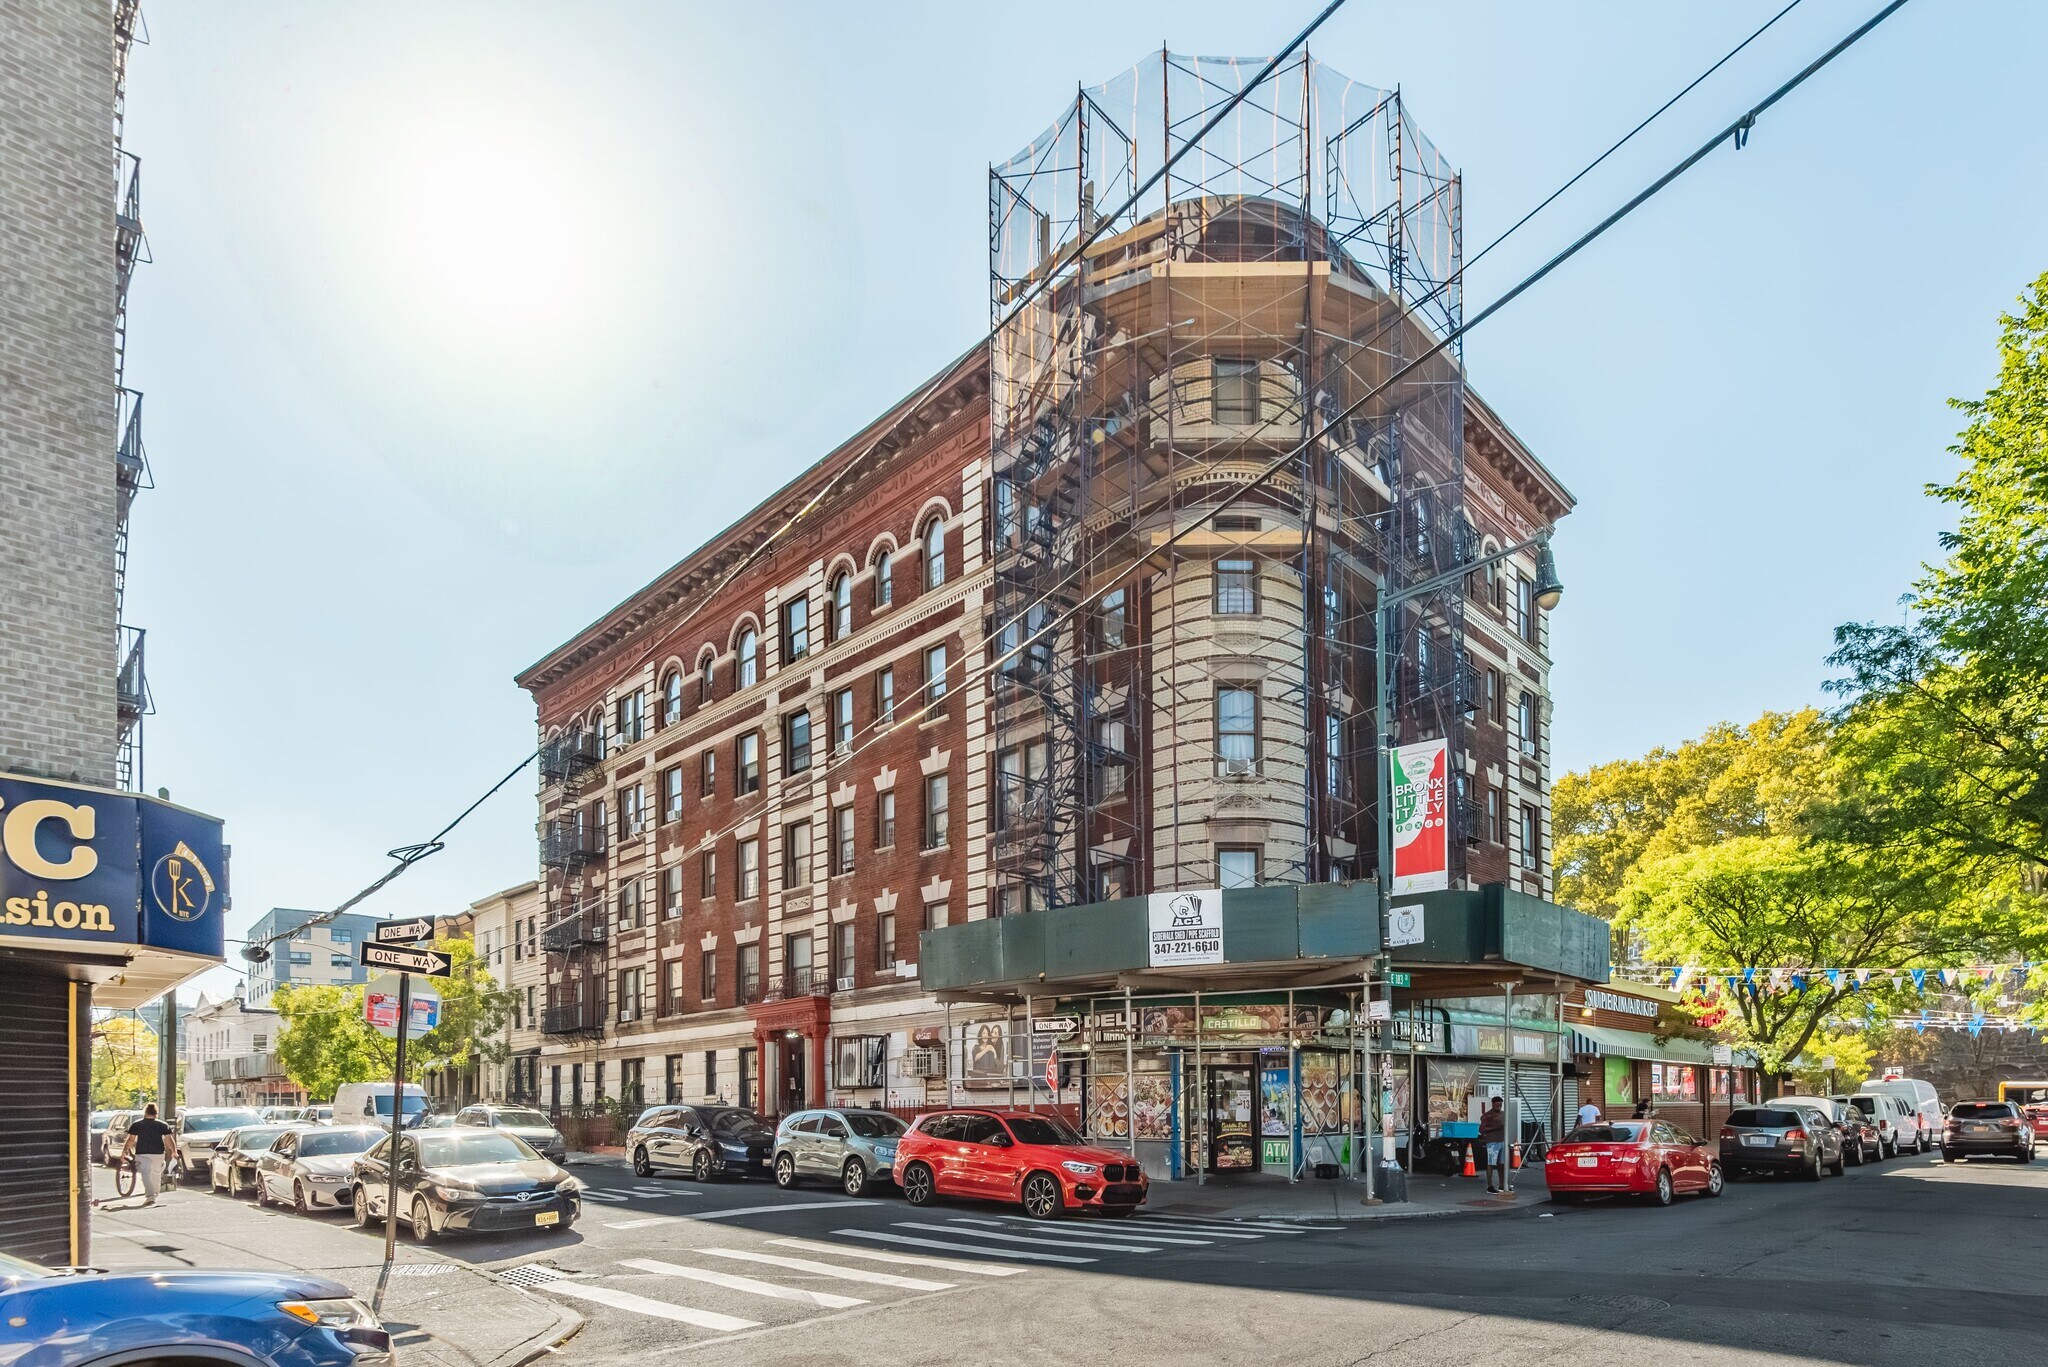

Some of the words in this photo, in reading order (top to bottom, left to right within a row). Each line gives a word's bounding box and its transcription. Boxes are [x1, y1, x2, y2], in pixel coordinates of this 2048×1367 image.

[1395, 777, 1444, 797] BRONX
[1395, 789, 1444, 808] LITTLE
[1396, 802, 1444, 820] ITALY
[1173, 917, 1202, 926] ACE
[384, 927, 402, 938] ONE
[408, 923, 427, 935] WAY
[1153, 931, 1174, 941] SIDEWALK
[1174, 930, 1186, 940] SHED
[1188, 928, 1198, 938] PIPE
[1198, 928, 1219, 938] SCAFFOLD
[1154, 940, 1219, 955] 347-221-6610
[374, 951, 401, 964] ONE
[413, 956, 439, 969] WAY
[1584, 990, 1659, 1018] SUPERMARKET
[1039, 1021, 1053, 1030] ONE
[1058, 1020, 1073, 1029] WAY
[1084, 1012, 1137, 1029] DELI
[1208, 1017, 1257, 1029] CASTILLO
[1265, 1142, 1290, 1157] ATM
